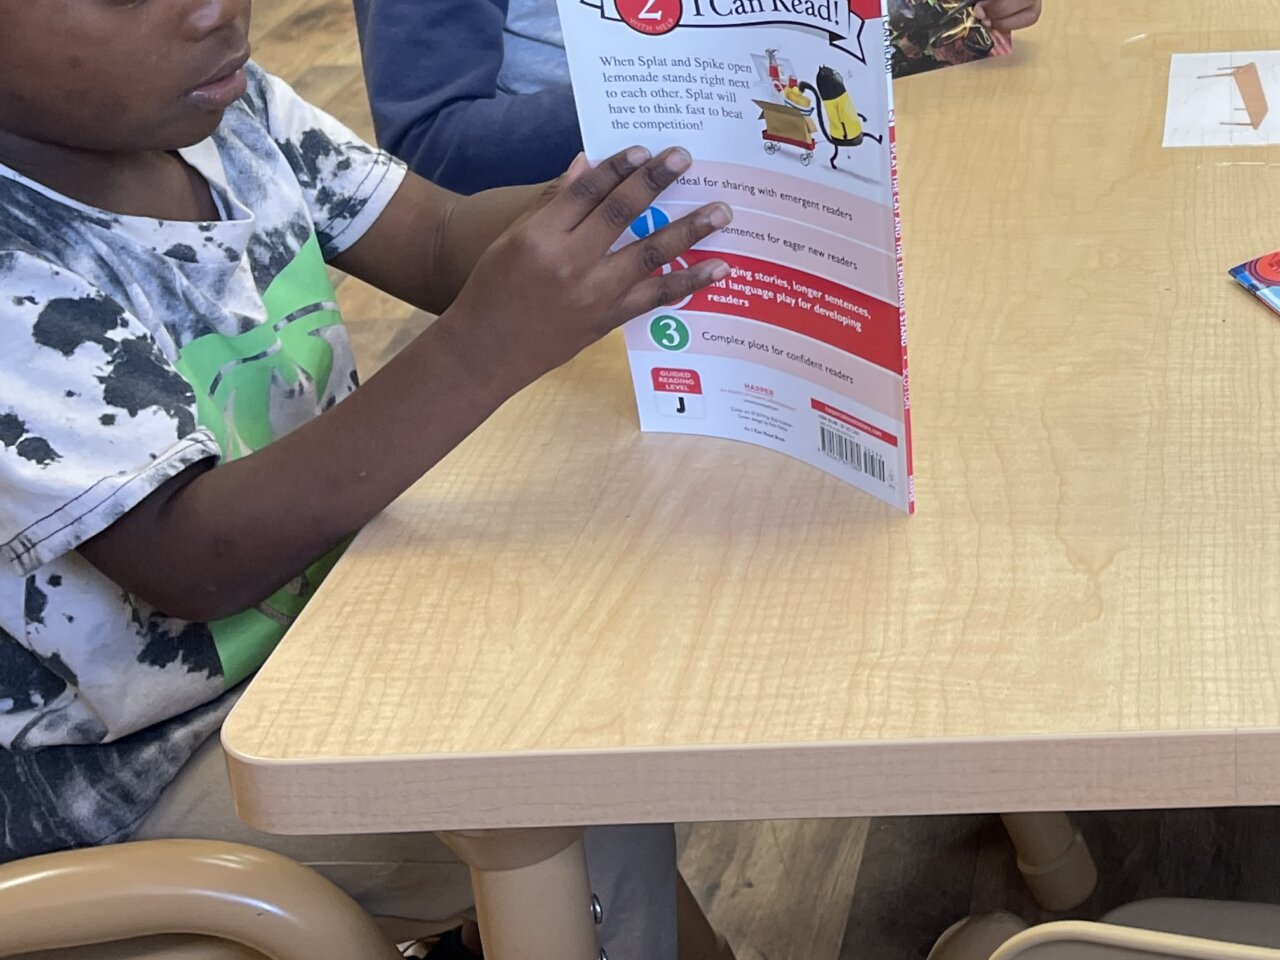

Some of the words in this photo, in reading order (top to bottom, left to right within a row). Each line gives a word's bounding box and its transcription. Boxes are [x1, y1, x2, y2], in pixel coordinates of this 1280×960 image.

[599, 56, 634, 67] When
[638, 56, 667, 69] Splat
[671, 57, 691, 67] and
[694, 57, 724, 71] Spike
[728, 63, 752, 74] open
[602, 72, 659, 83] lemonade
[662, 72, 697, 83] stands
[700, 74, 725, 87] right
[728, 79, 750, 89] next
[605, 90, 617, 98] to
[620, 88, 647, 98] each
[685, 89, 713, 101] Splat
[717, 92, 737, 103] will
[608, 104, 636, 114] have
[639, 104, 650, 113] to
[654, 103, 683, 114] think
[686, 104, 706, 115] fast
[708, 107, 719, 117] to
[722, 107, 743, 119] beat
[611, 120, 630, 130] the
[633, 120, 704, 132] competition!
[704, 177, 719, 187] for
[722, 179, 755, 196] sharing
[758, 187, 777, 198] with
[780, 192, 820, 210] emergent
[822, 204, 853, 221] readers
[721, 227, 765, 241] sentences
[767, 234, 780, 244] for
[783, 240, 806, 252] eager
[808, 246, 825, 257] new
[827, 252, 858, 270] readers
[896, 261, 906, 311] LEMONADE
[707, 294, 749, 307] readers
[755, 272, 791, 290] stories,
[793, 281, 823, 298] longer
[824, 293, 871, 319] sentences,
[729, 280, 774, 299] language
[776, 292, 795, 307] play
[798, 296, 812, 310] for
[814, 303, 862, 332] developing
[659, 319, 679, 347] 3
[702, 331, 745, 346] Complex
[748, 339, 769, 352] plots
[771, 344, 784, 355] for
[786, 351, 823, 372] confident
[825, 366, 854, 384] readers
[658, 377, 695, 385] READING
[660, 370, 691, 378] GUIDED
[676, 397, 686, 413] J
